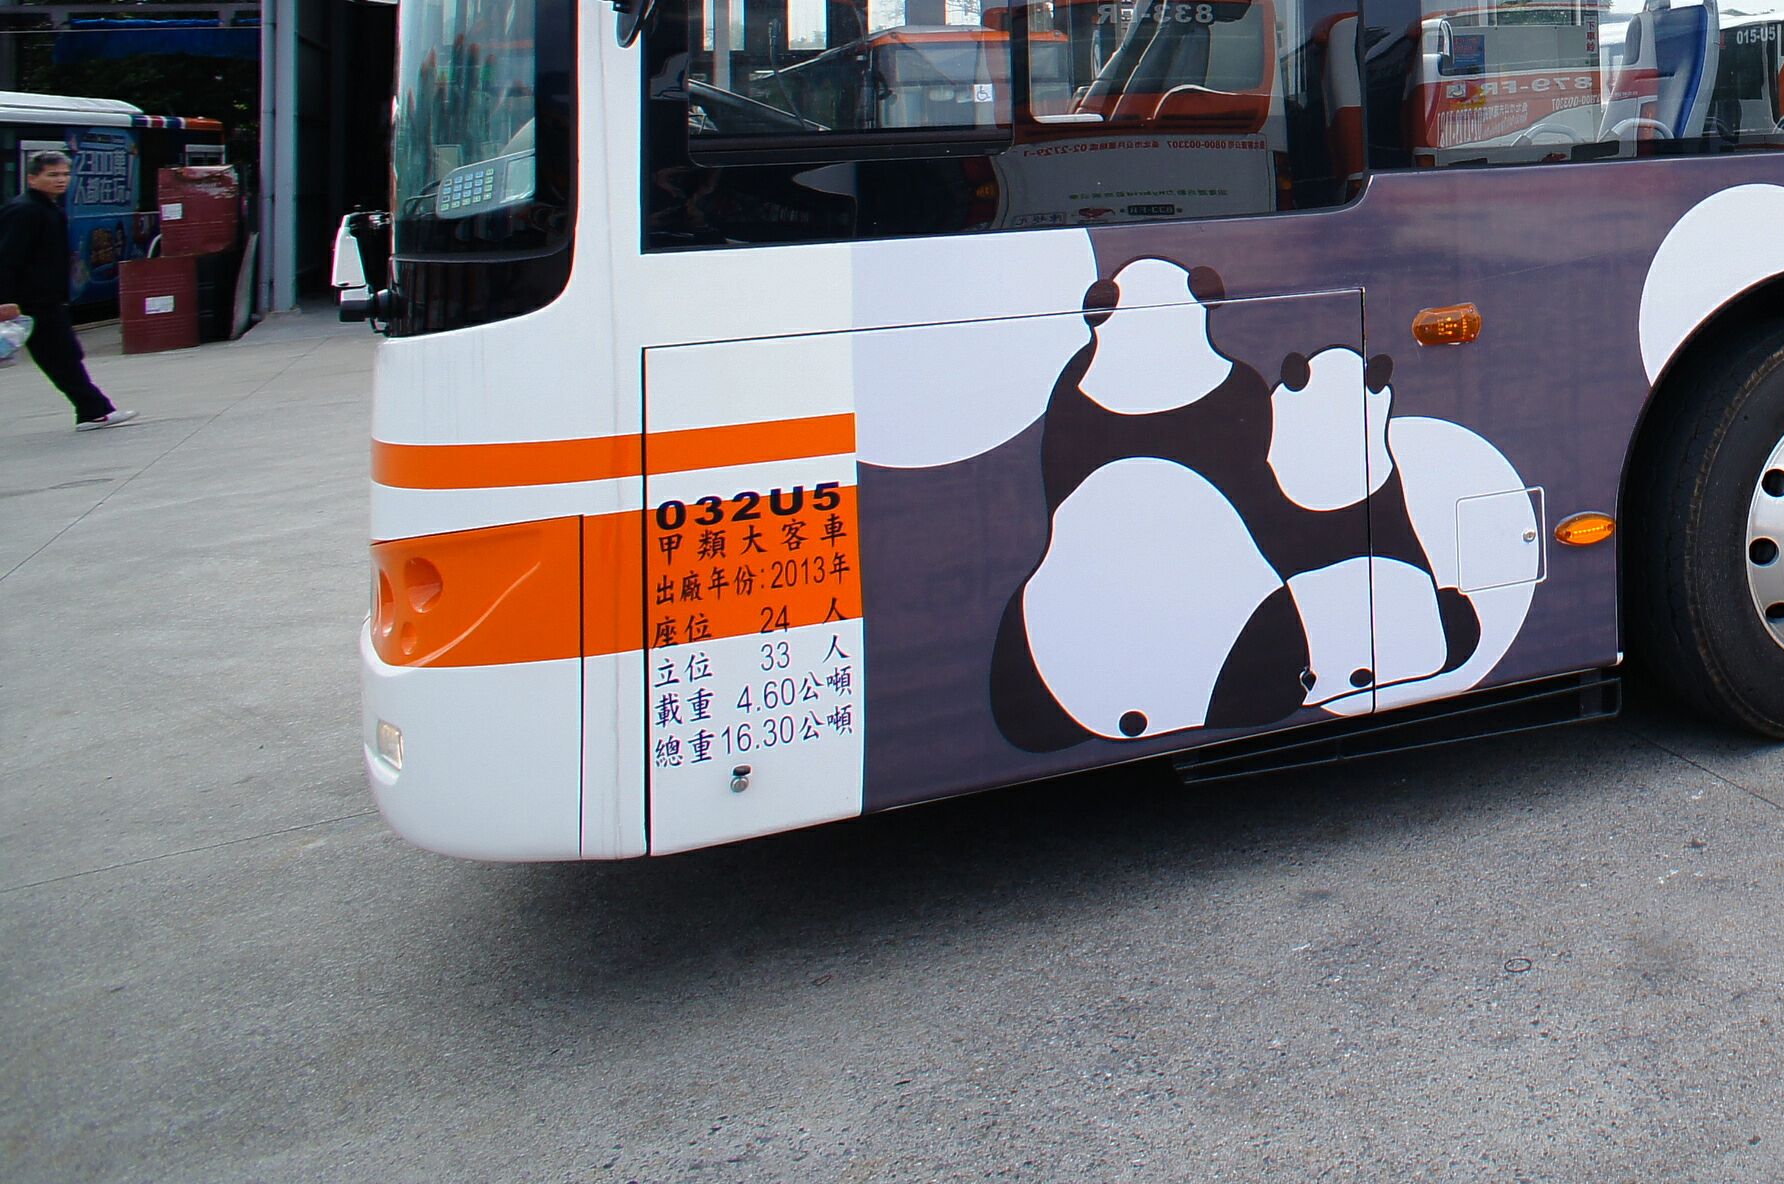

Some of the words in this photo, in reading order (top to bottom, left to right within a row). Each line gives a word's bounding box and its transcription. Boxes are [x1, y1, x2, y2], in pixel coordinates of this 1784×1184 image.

[1736, 26, 1776, 45] 015-U5
[655, 481, 841, 530] 032U5
[658, 513, 847, 566] 甲類大客車
[651, 613, 713, 649] 座位
[760, 605, 791, 634] 24
[822, 596, 848, 625] 人
[654, 652, 713, 689] 立位
[760, 641, 791, 671] 33
[822, 634, 849, 664] 人
[654, 687, 714, 728] 載重
